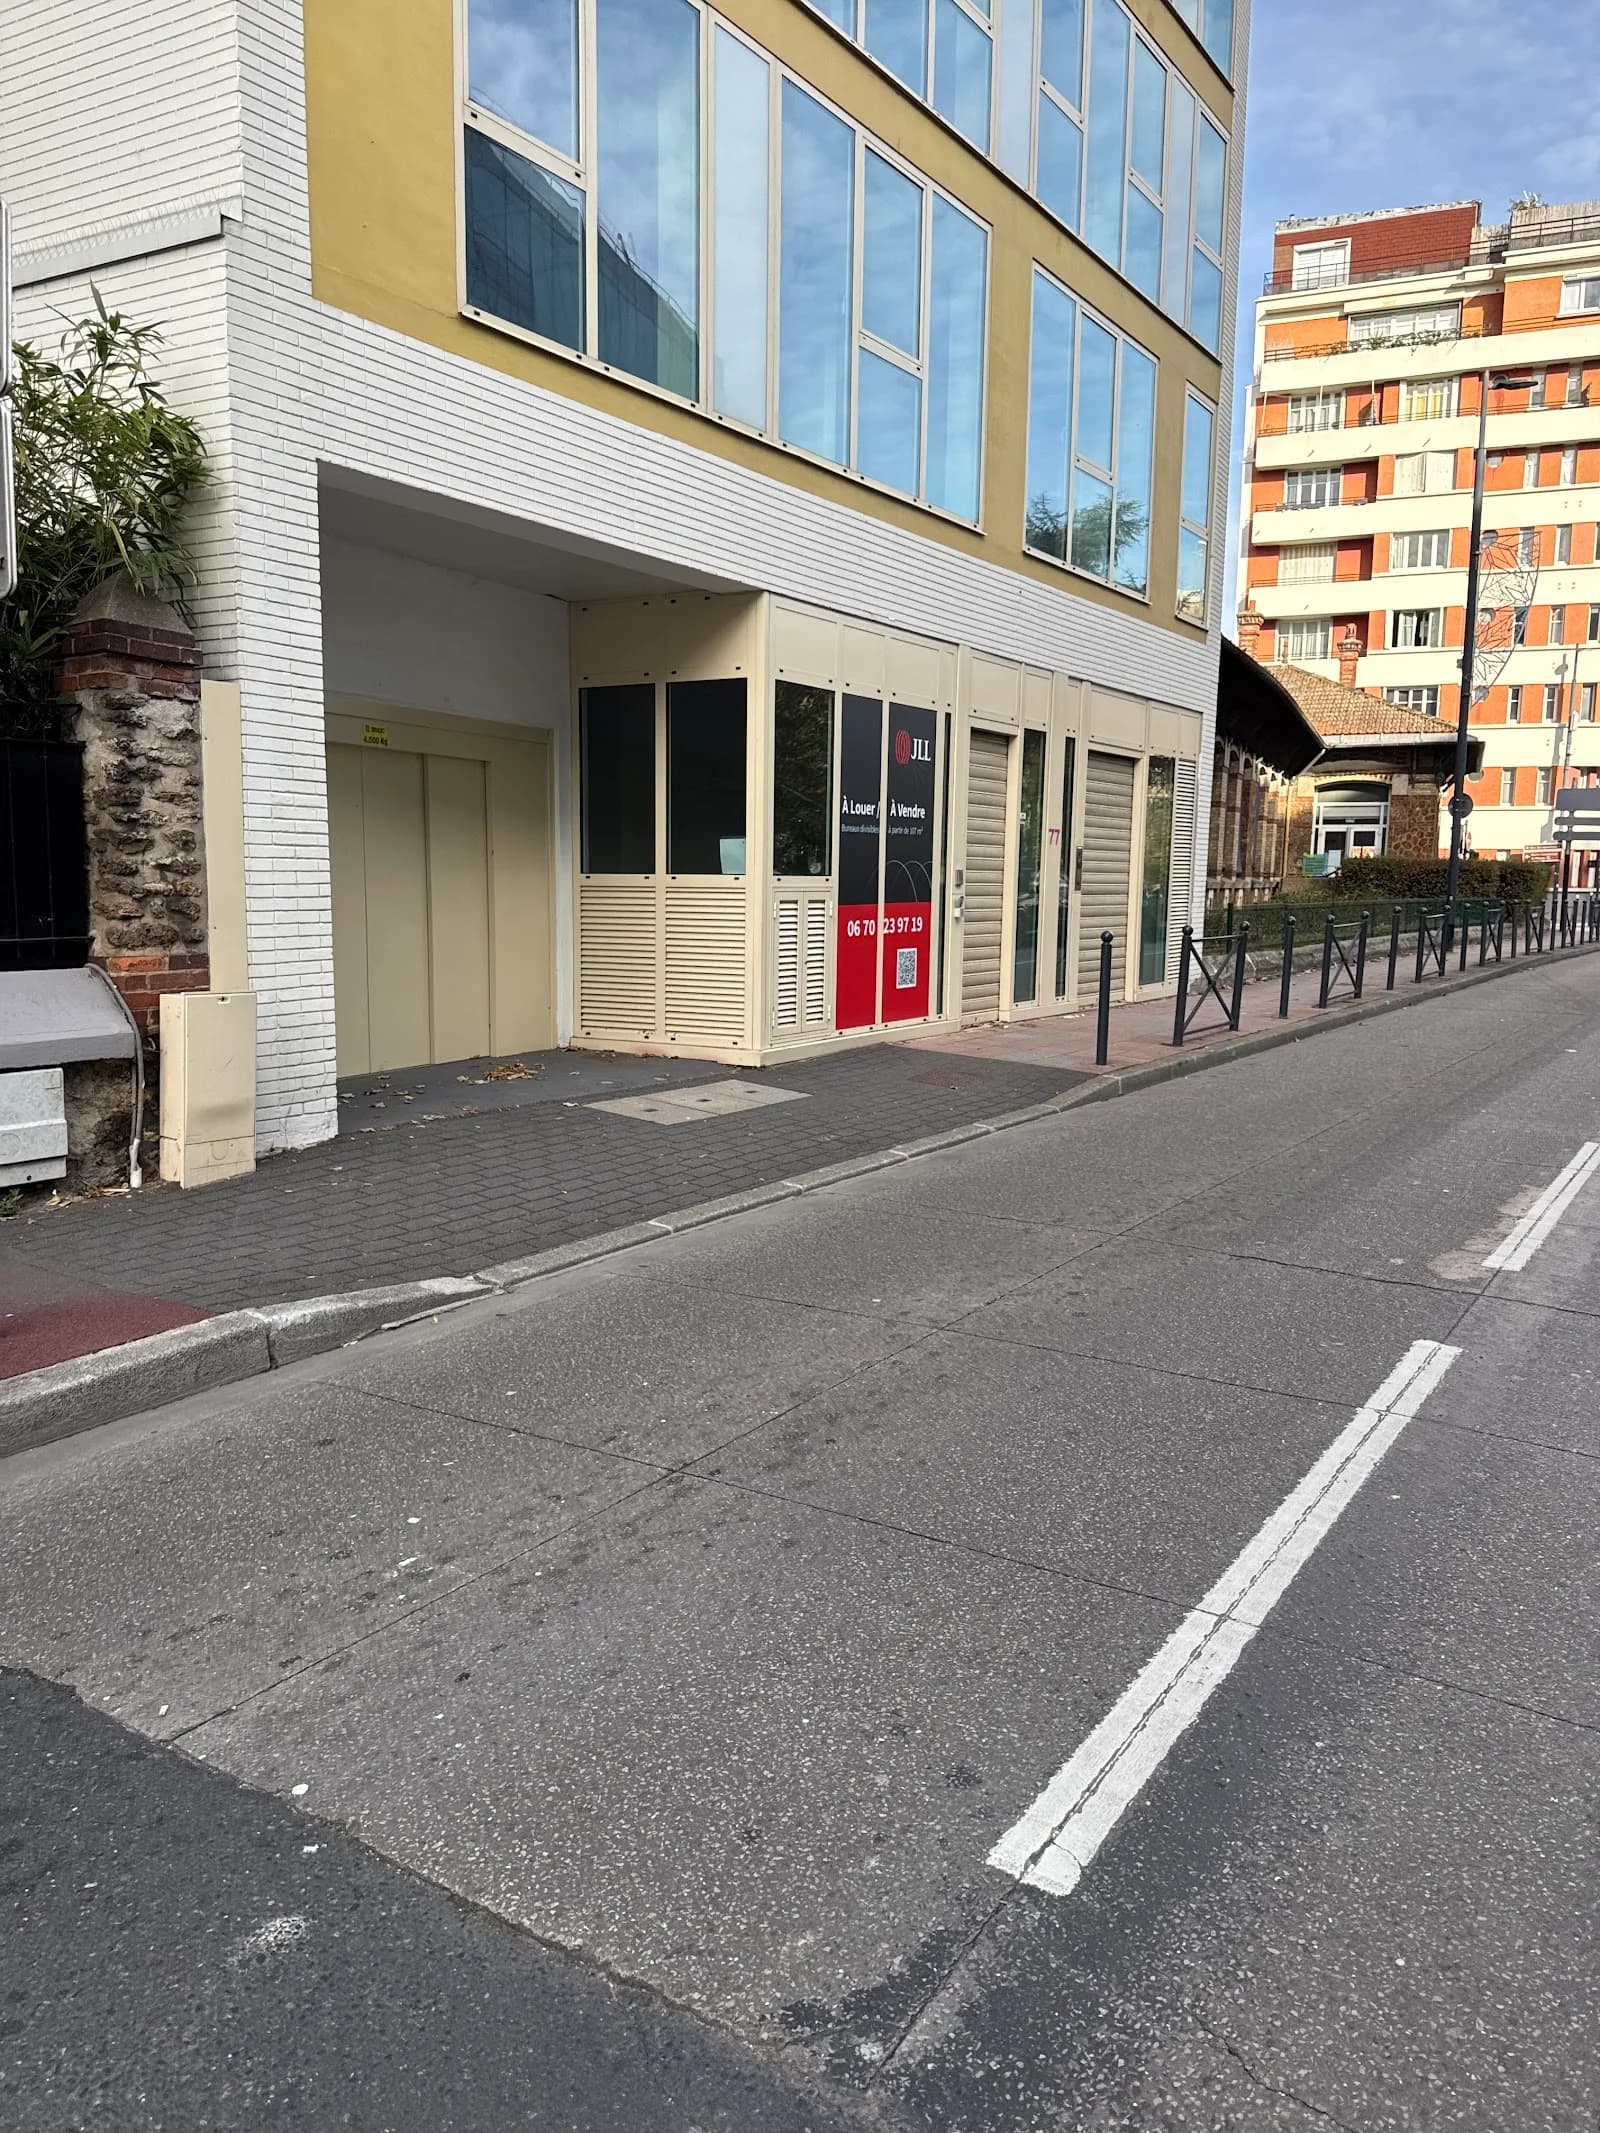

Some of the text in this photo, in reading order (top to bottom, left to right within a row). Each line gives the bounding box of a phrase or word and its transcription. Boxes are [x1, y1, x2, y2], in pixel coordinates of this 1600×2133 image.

[911, 738, 931, 761] JLL
[841, 795, 849, 814] À
[850, 799, 876, 816] Louer
[890, 798, 896, 817] À
[897, 803, 926, 819] Vendre
[1048, 829, 1060, 845] 77
[848, 917, 922, 936] 06 70 23 97 19
